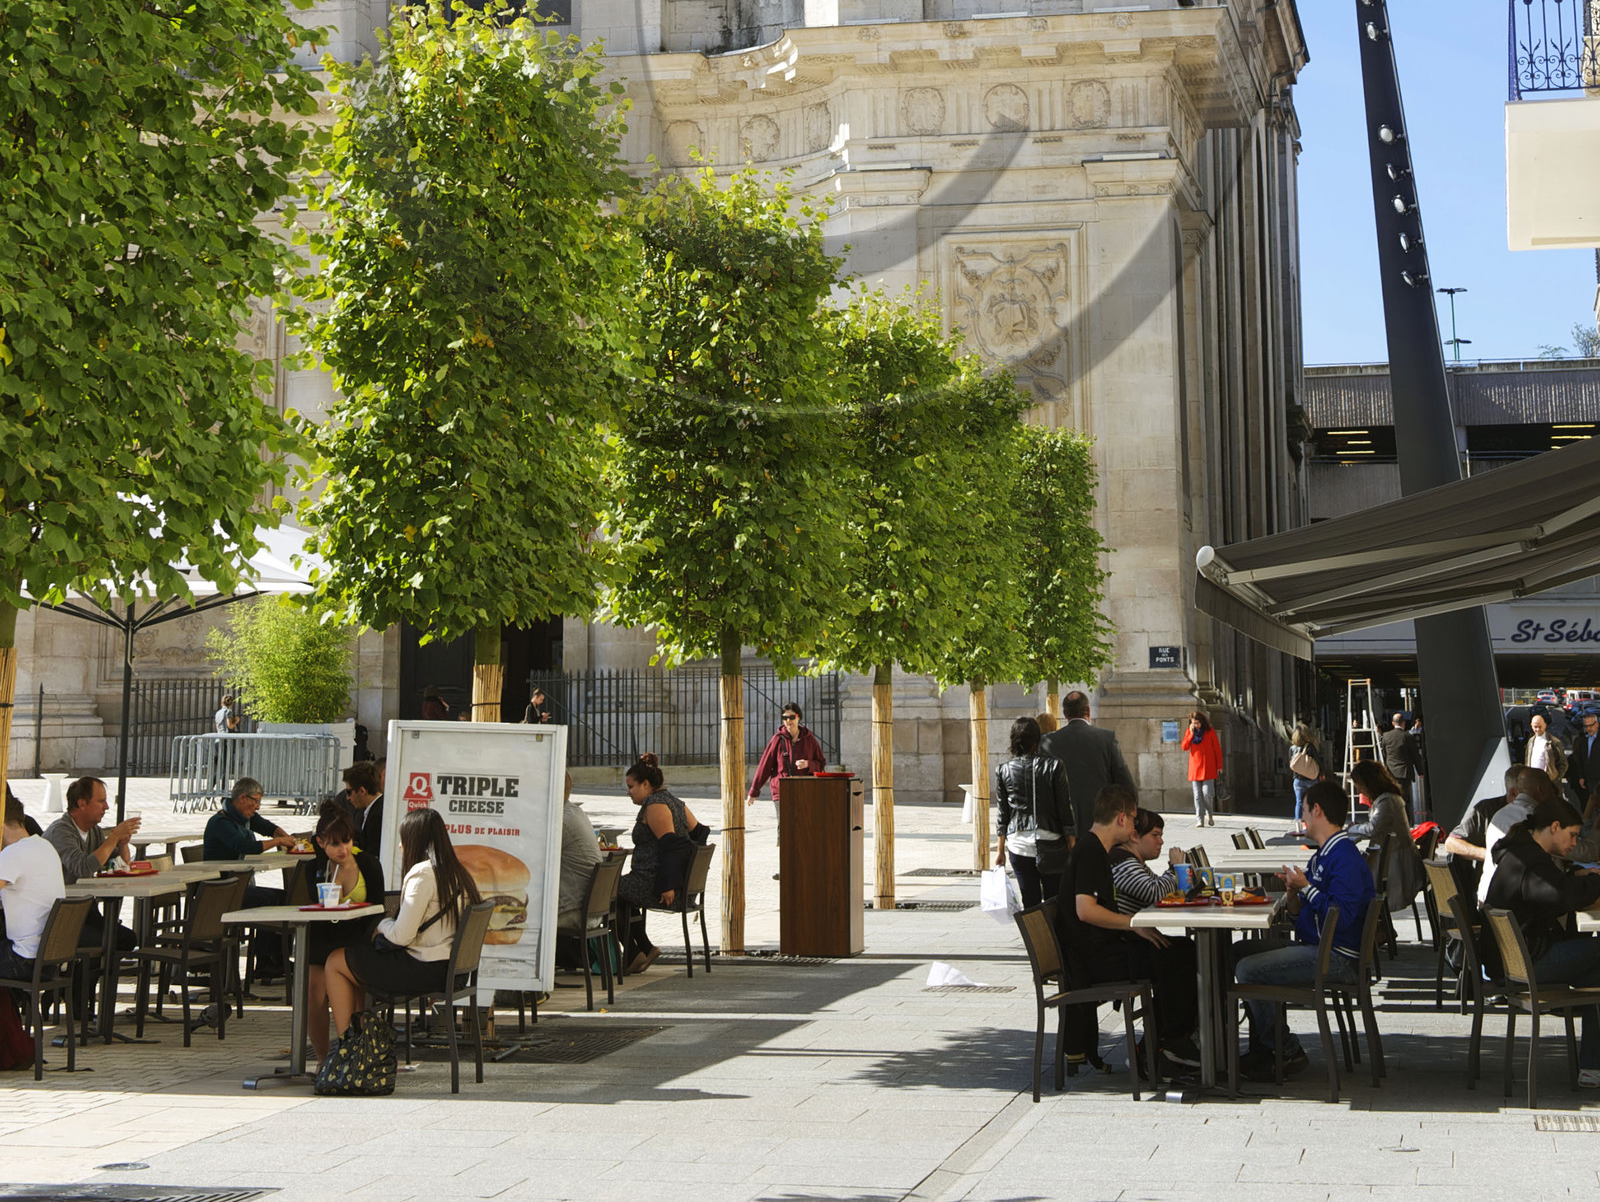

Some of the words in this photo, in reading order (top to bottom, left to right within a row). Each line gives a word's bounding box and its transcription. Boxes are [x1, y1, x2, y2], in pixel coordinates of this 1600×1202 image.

[1511, 619, 1545, 642] St
[411, 776, 428, 797] Q
[436, 775, 520, 798] TRIPLE
[408, 801, 427, 809] Quick
[448, 799, 505, 814] CHEESE
[445, 824, 472, 835] PLUS
[474, 827, 485, 835] DE
[487, 827, 520, 837] PLAISIR
